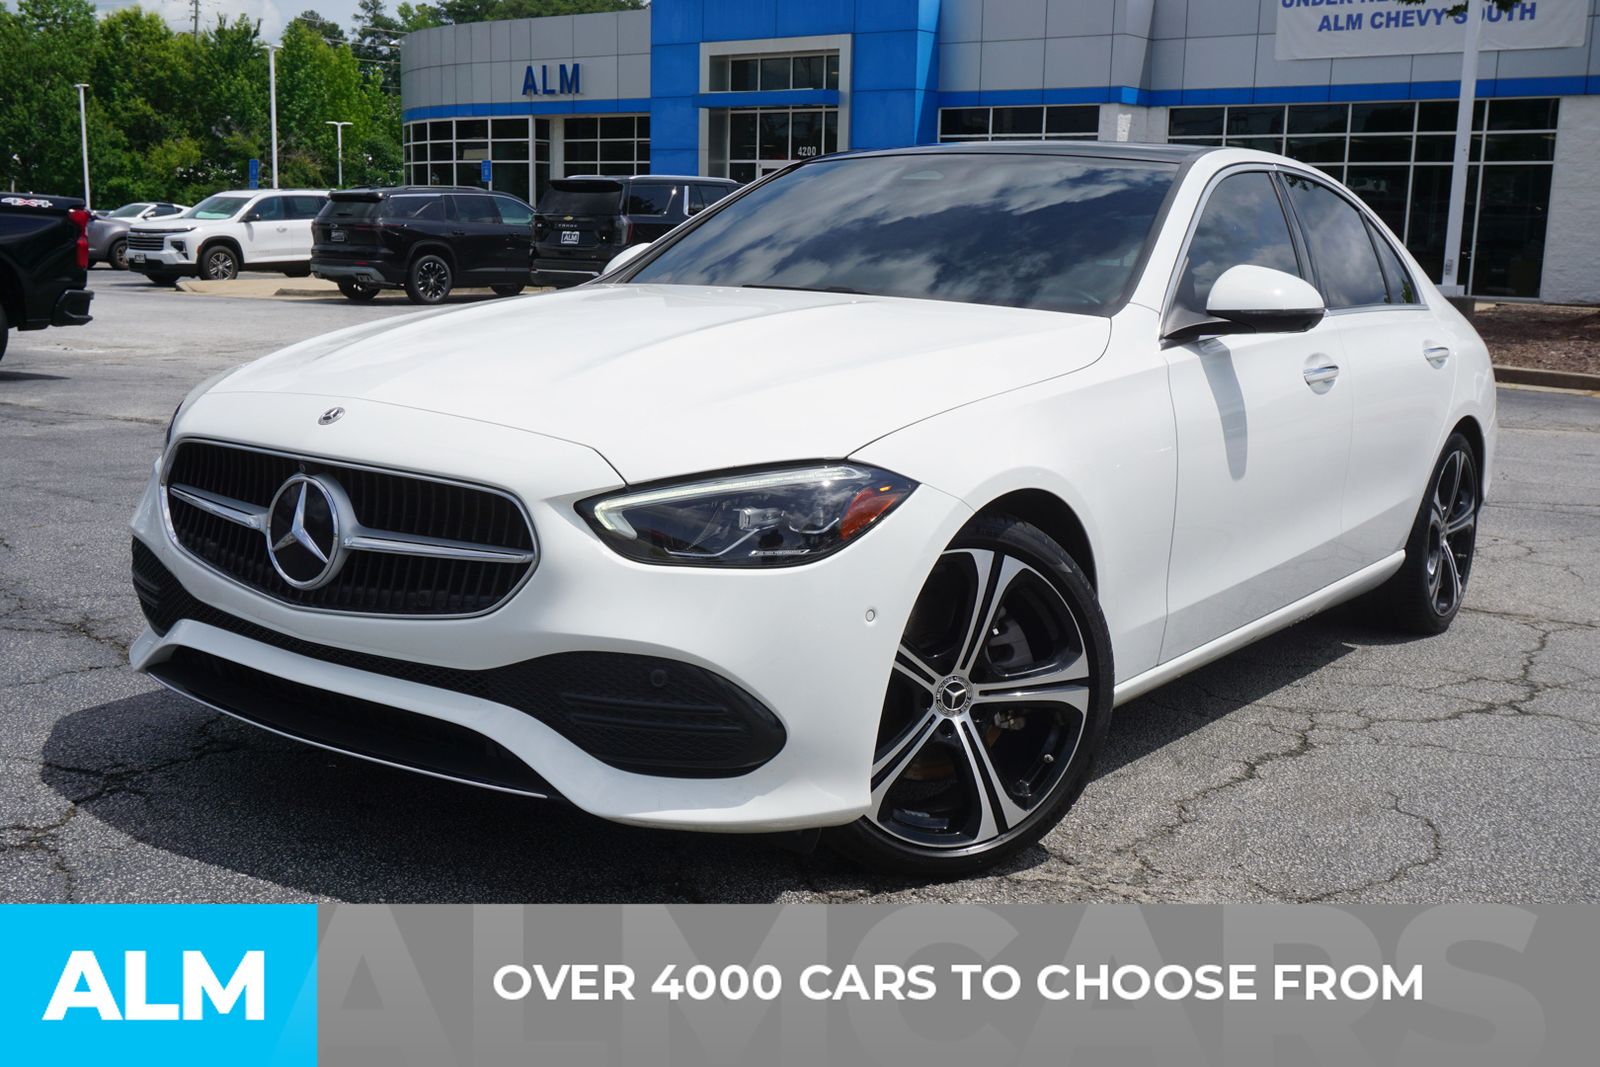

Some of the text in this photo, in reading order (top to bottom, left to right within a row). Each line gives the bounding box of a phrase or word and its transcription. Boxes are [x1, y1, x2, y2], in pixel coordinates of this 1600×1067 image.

[1317, 2, 1537, 32] ALM CHEVY SUTH
[521, 63, 580, 96] ALM
[797, 146, 817, 156] 4200
